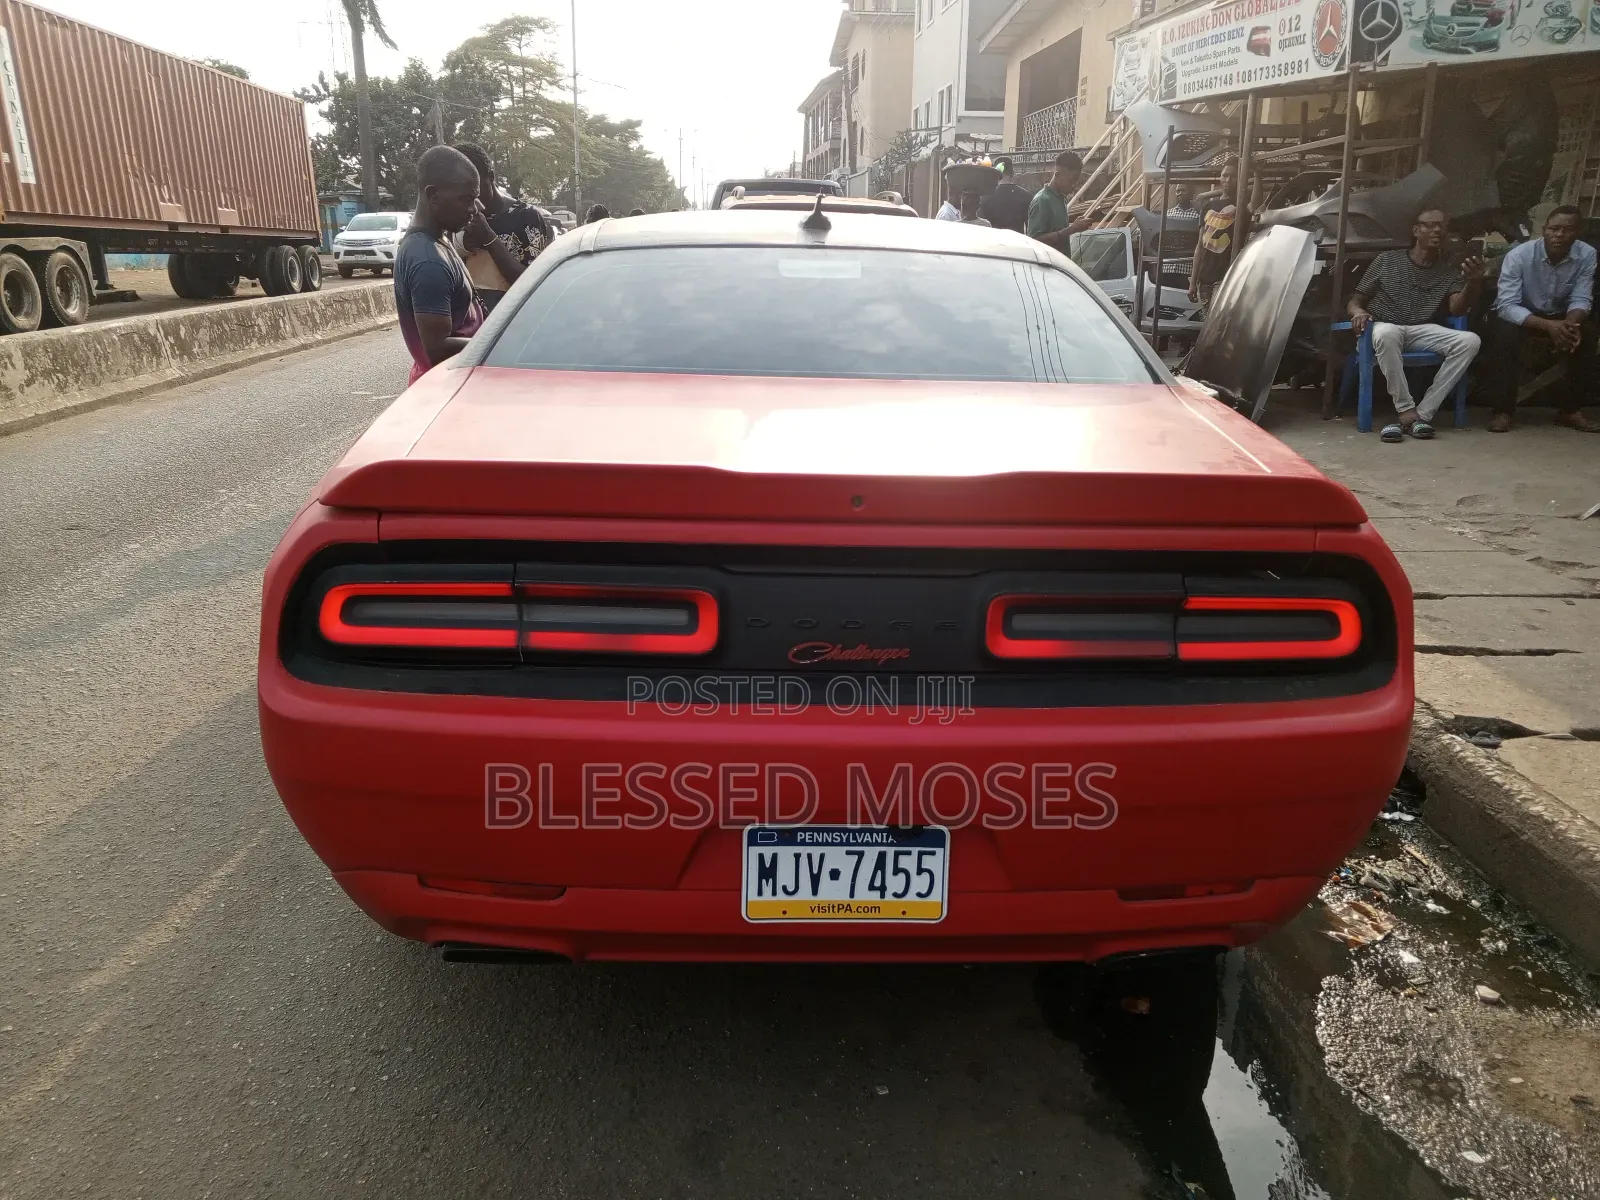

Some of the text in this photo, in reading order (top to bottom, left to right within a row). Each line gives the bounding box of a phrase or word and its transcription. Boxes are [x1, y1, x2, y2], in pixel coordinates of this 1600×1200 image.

[1234, 0, 1276, 21] GLOBAL
[1187, 41, 1195, 53] OF
[1195, 31, 1227, 52] MERCEDES
[1227, 26, 1245, 41] BENZ
[1212, 50, 1227, 60] Spare
[1202, 63, 1218, 71] Laest
[1218, 57, 1239, 68] Models
[1183, 73, 1234, 95] 08034467148
[1241, 58, 1309, 84] 08173358981
[797, 832, 897, 843] PENNSYLVANIA
[809, 903, 881, 914] visitPA.com
